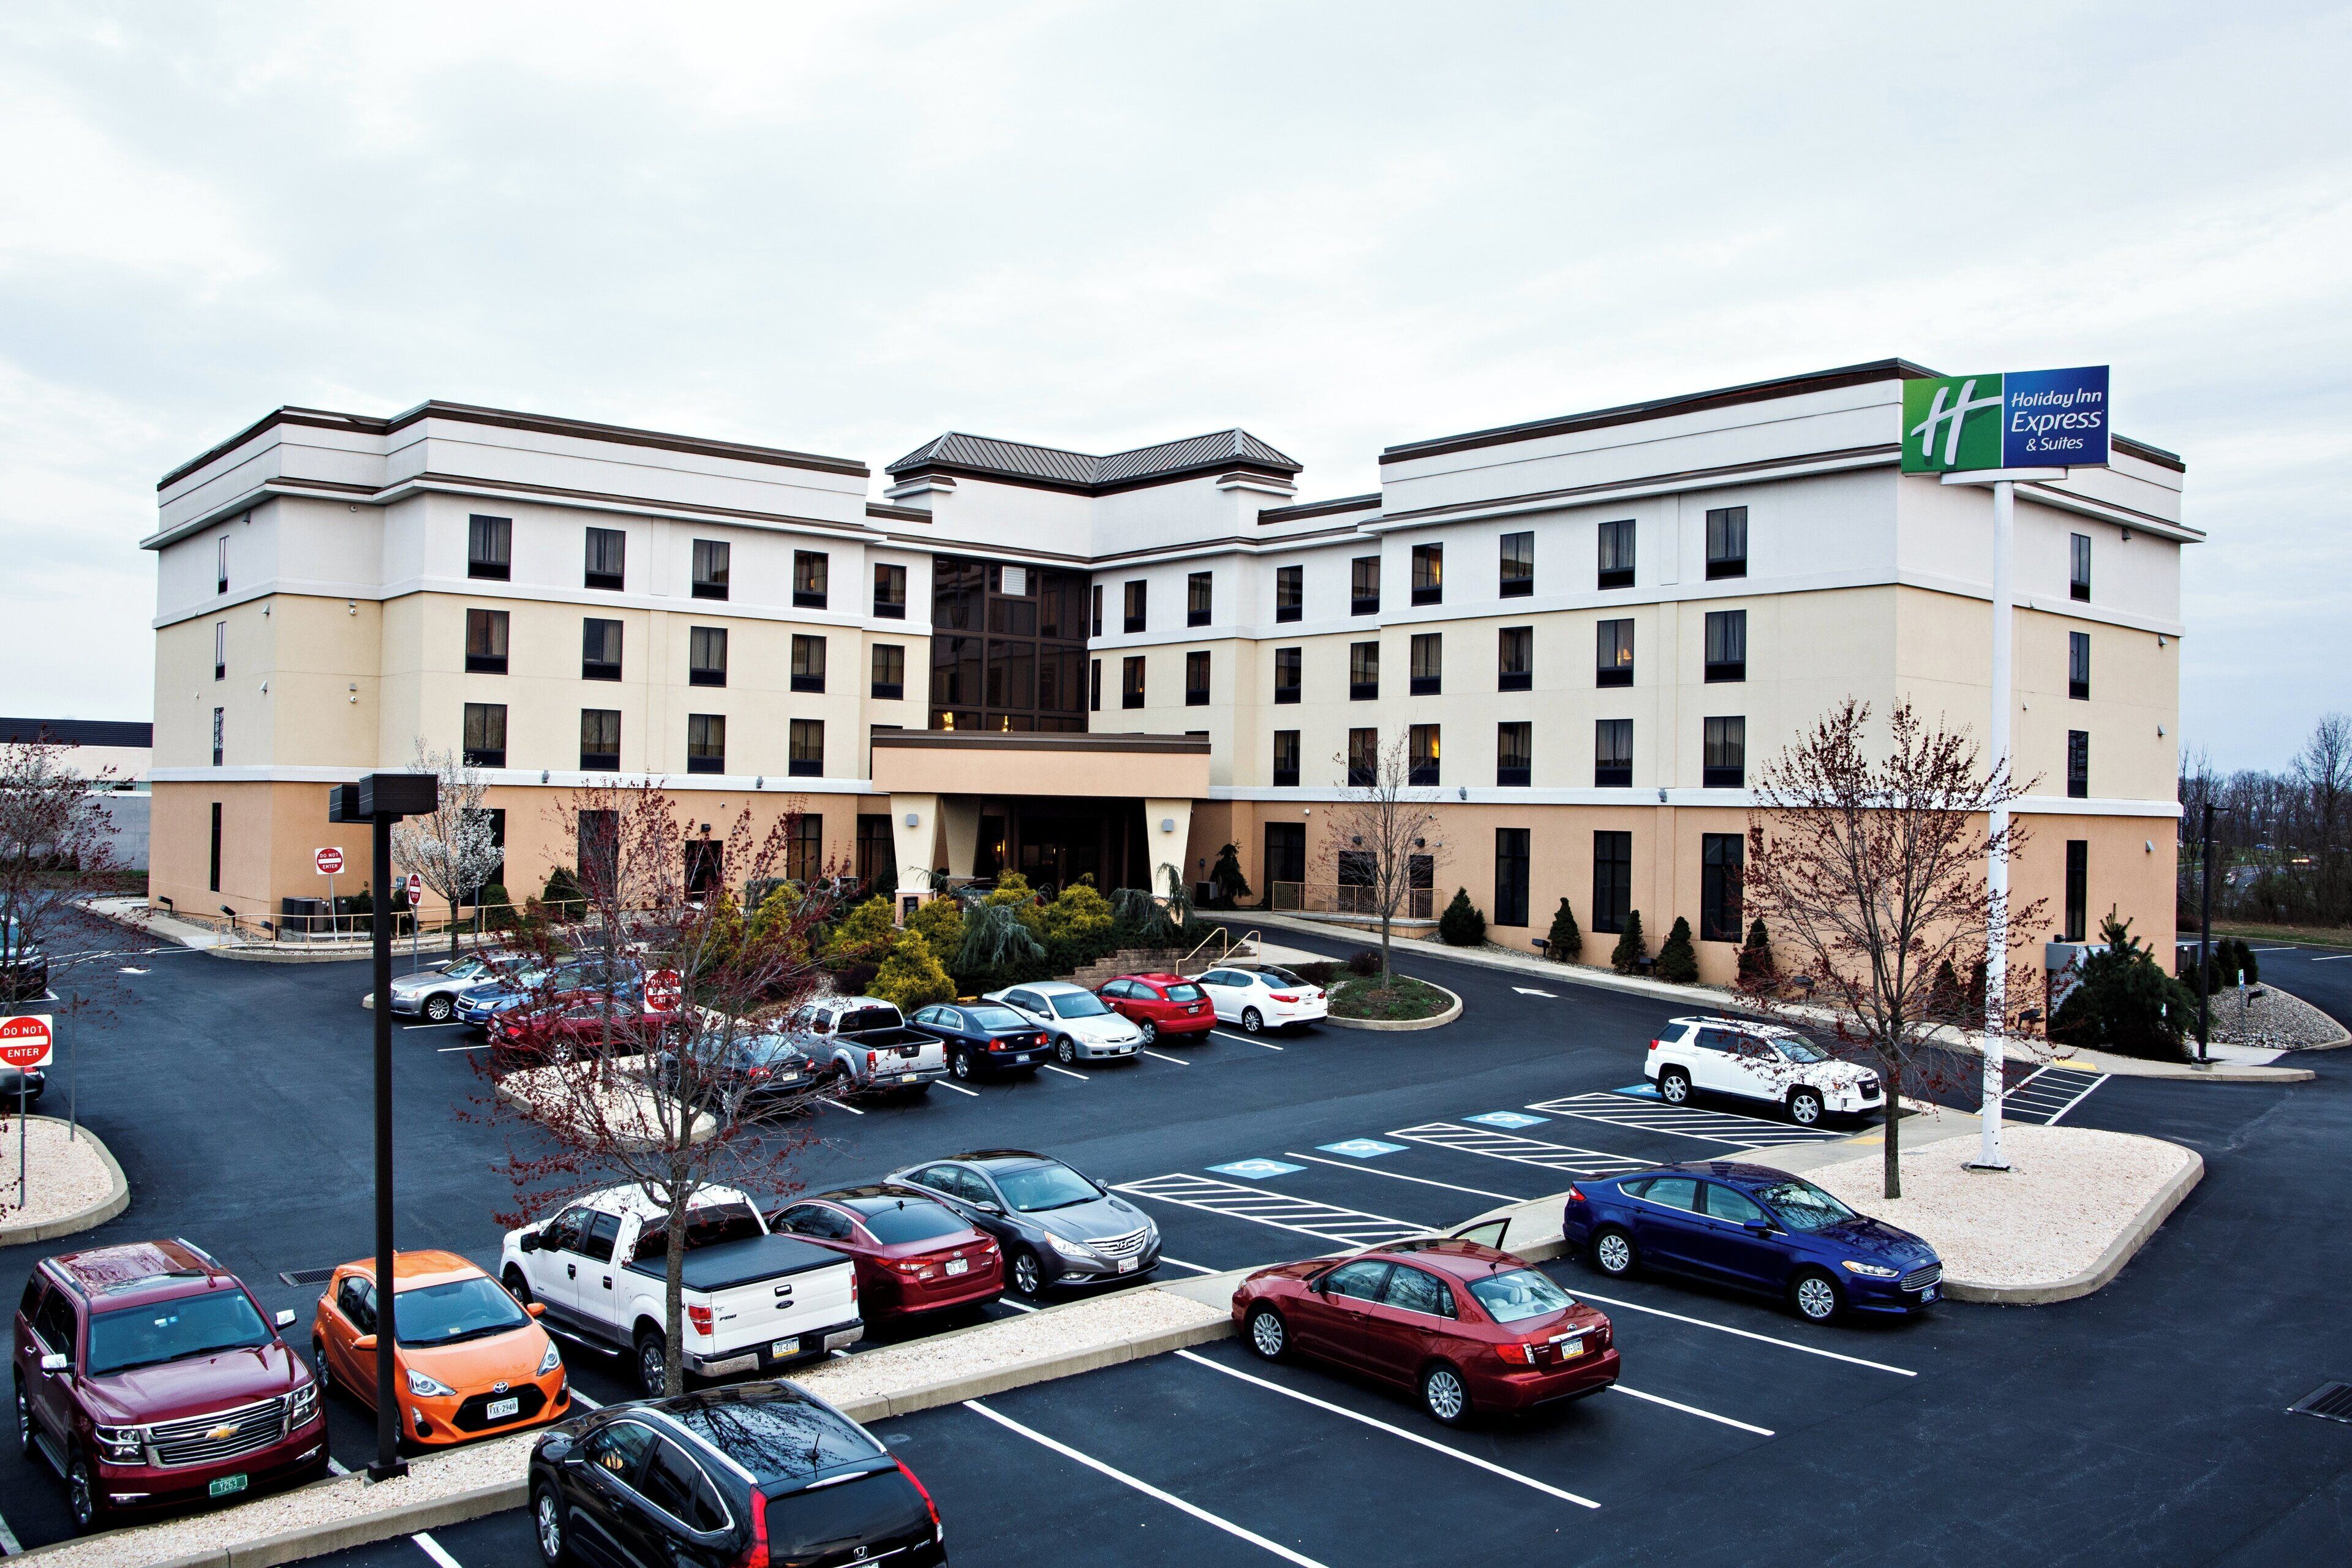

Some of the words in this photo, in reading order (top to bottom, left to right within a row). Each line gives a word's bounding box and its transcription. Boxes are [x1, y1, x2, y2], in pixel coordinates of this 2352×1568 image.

[2011, 390, 2074, 408] Holiday
[2076, 388, 2102, 404] Inn
[2011, 411, 2101, 437] Express
[2026, 438, 2037, 451] &
[2039, 436, 2084, 451] Suites
[4, 1027, 18, 1036] DO
[22, 1025, 43, 1035] NOT
[7, 1047, 39, 1058] ENTER
[489, 1402, 516, 1415] VXK-2940
